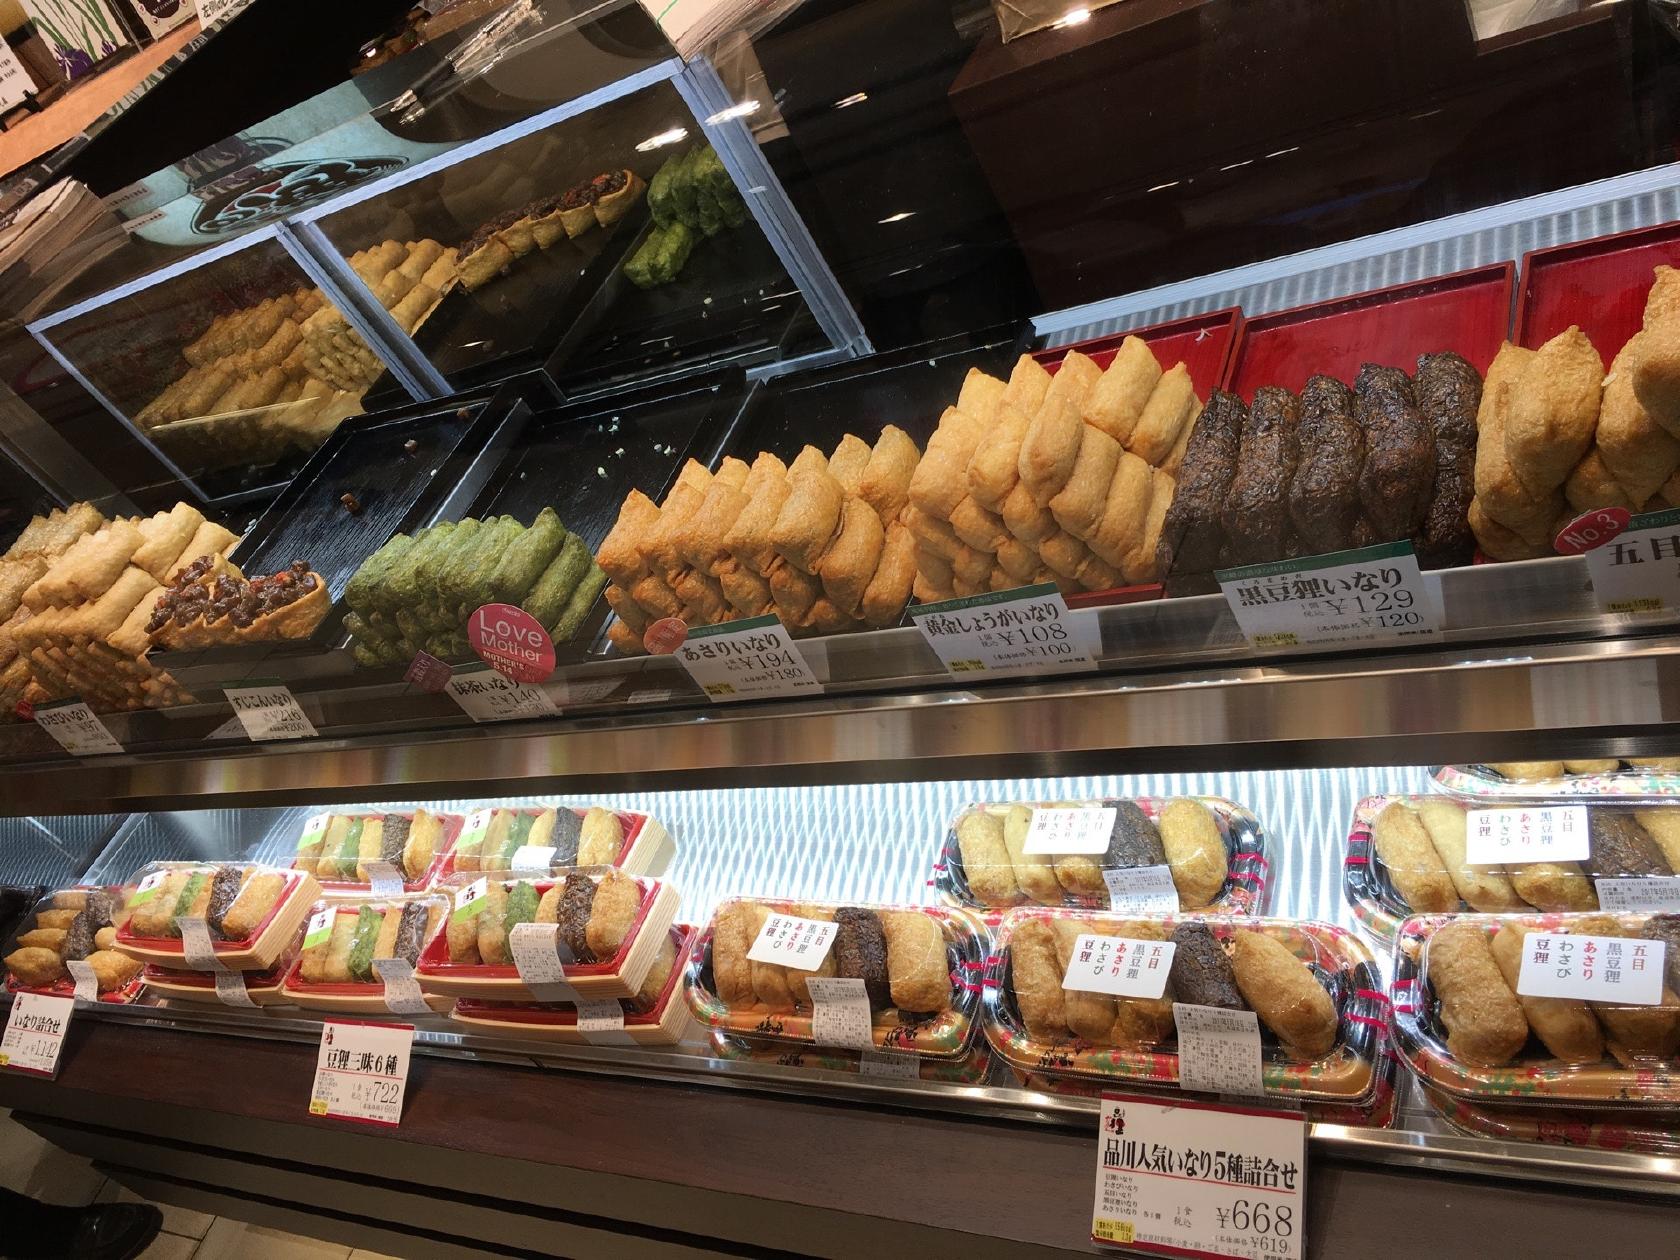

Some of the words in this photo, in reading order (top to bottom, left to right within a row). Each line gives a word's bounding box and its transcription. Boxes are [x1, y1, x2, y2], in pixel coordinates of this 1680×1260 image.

[1563, 513, 1619, 550] No.3
[1236, 567, 1402, 607] 黒豆狸いなり
[1325, 589, 1414, 616] ¥129
[480, 609, 543, 648] Love
[925, 602, 1059, 637] 黄金しょうがいなり
[998, 622, 1067, 647] ¥108
[481, 631, 543, 663] Mother
[483, 650, 525, 671] MOTHER'S
[683, 632, 781, 662] あさりいなり
[737, 649, 796, 671] ¥194
[1519, 813, 1531, 845] あさり
[1080, 940, 1095, 963] 豆狸
[1093, 941, 1111, 975] わさび
[1111, 941, 1127, 977] あさり
[1126, 943, 1145, 979] 黒豆狸
[1148, 946, 1163, 969] 五目
[1533, 938, 1551, 964] 豆狸
[1556, 940, 1574, 978] わさび
[1583, 940, 1598, 981] あさり
[1604, 942, 1622, 984] 黒豆狸
[1632, 945, 1648, 971] 五目
[14, 1013, 61, 1034] いなり詰合せ
[366, 1081, 399, 1104] ¥722
[1103, 1138, 1298, 1190] 品川人気いなり5種詰合せ
[1216, 1199, 1292, 1237] ¥668
